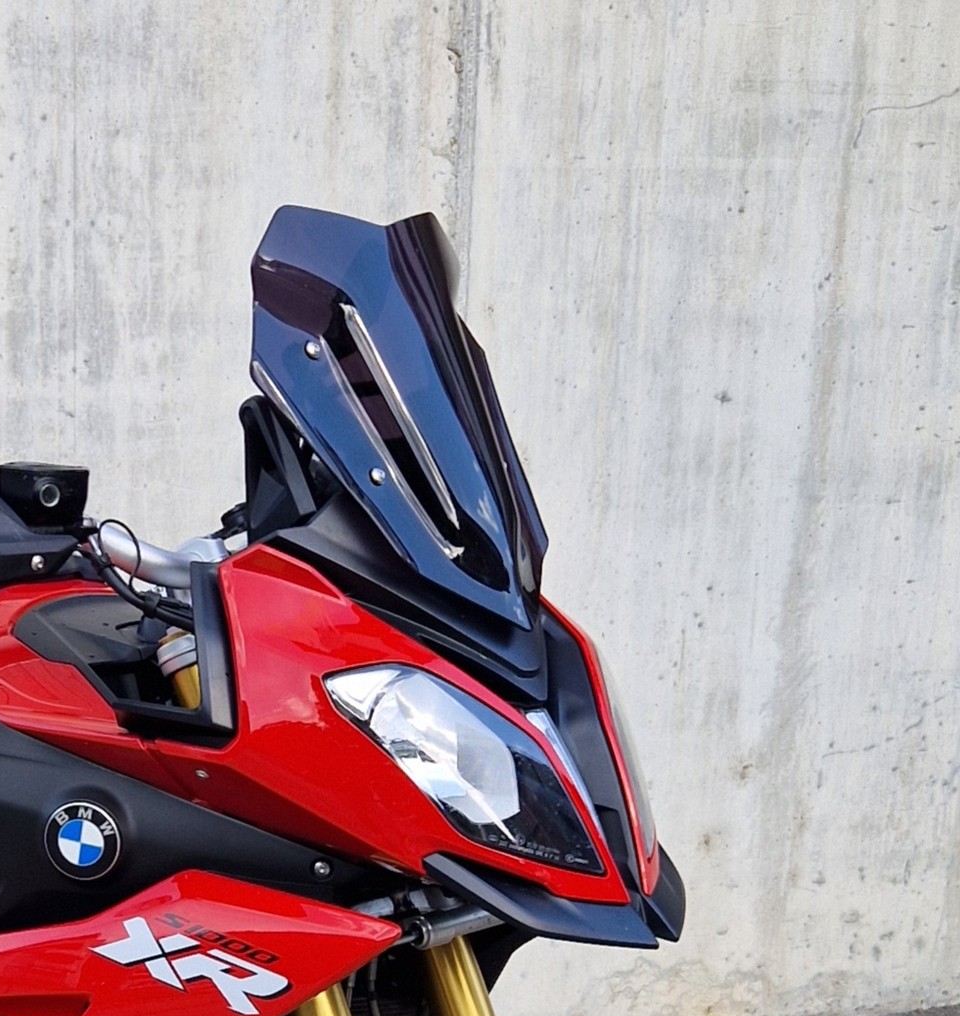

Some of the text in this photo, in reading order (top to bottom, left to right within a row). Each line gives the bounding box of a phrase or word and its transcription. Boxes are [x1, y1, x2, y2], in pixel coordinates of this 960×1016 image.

[54, 806, 114, 836] BMW
[155, 912, 281, 965] S 1000
[87, 915, 293, 1016] XR
